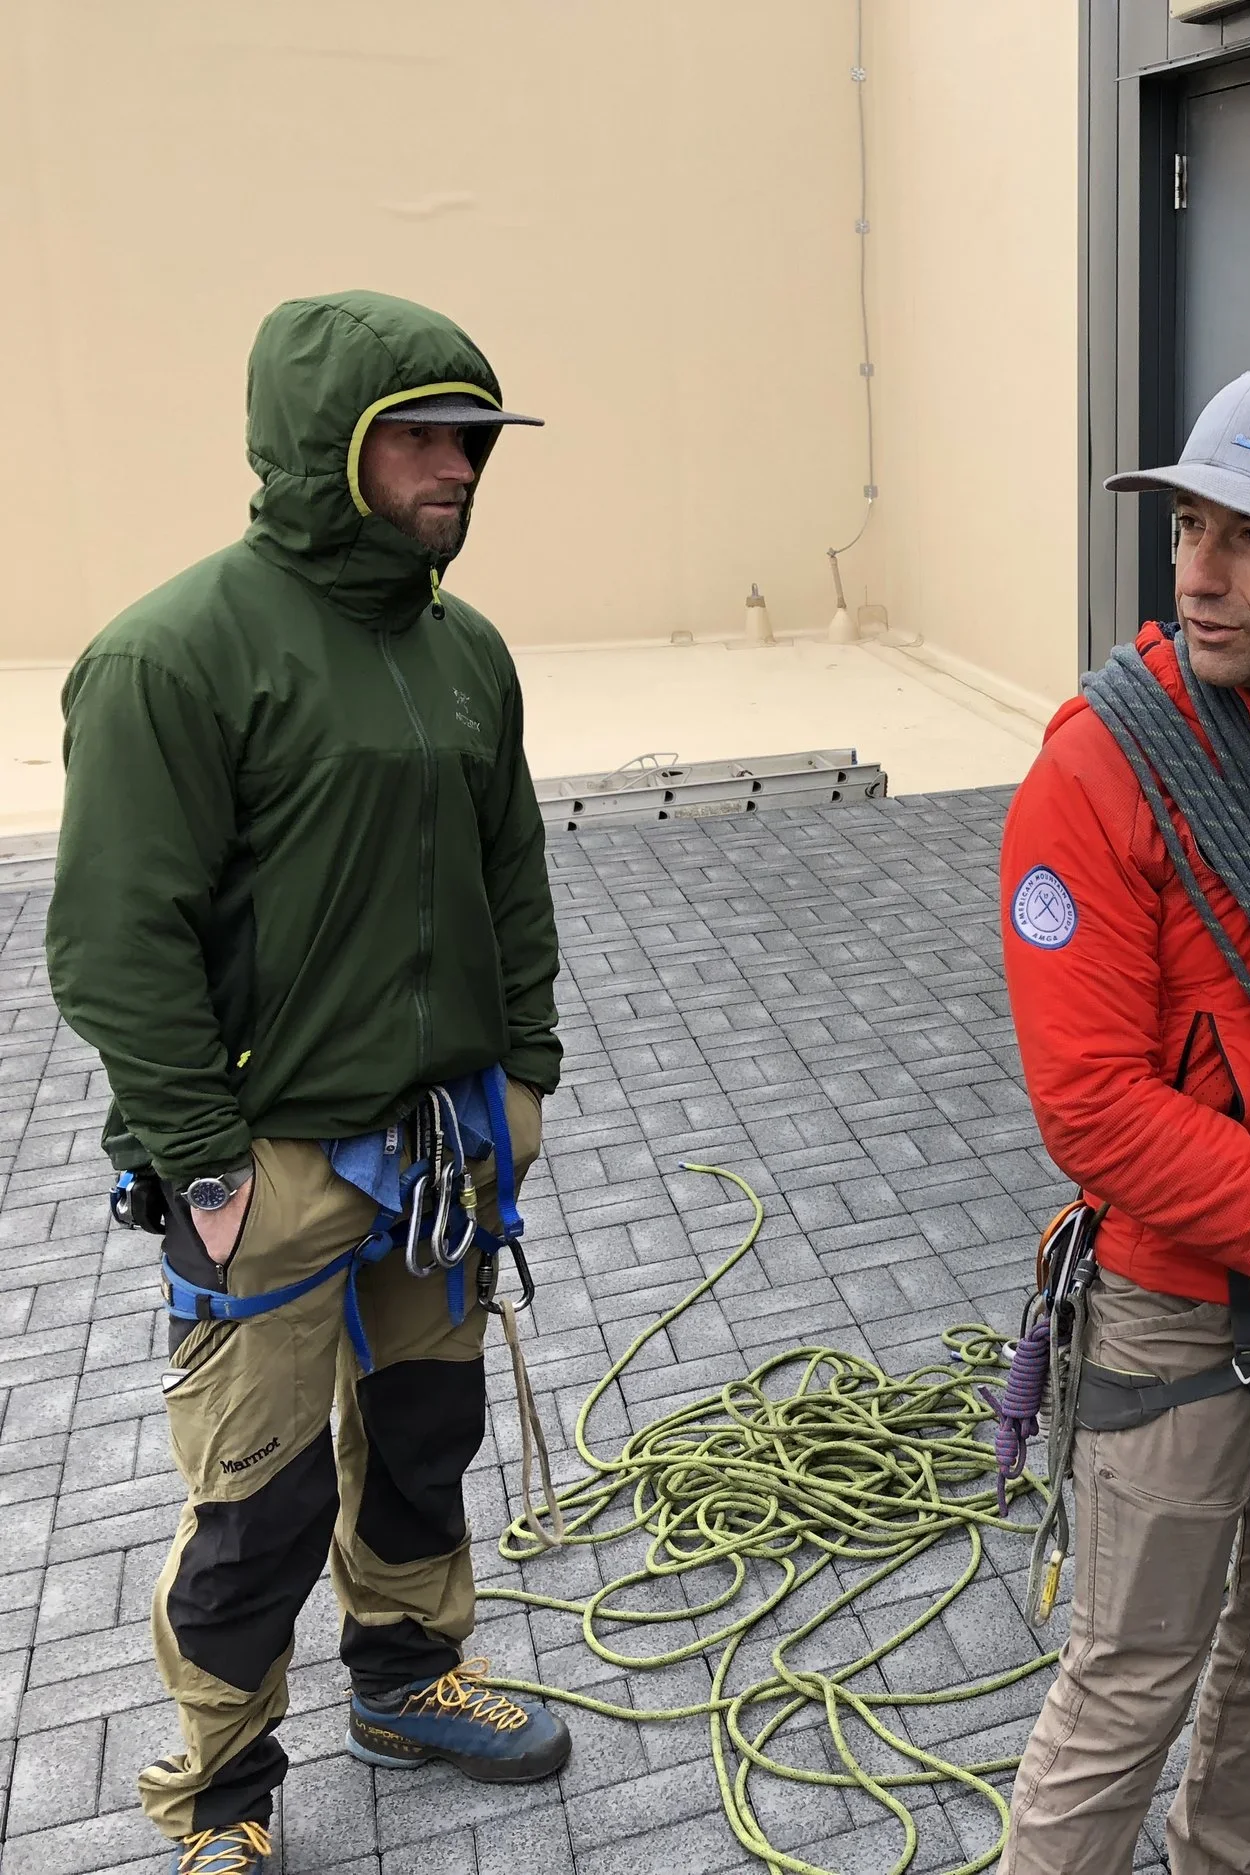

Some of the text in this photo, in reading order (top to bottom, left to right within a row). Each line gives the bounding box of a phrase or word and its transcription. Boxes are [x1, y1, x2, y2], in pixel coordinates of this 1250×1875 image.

[1018, 880, 1034, 925] AMERICAN
[1035, 873, 1067, 899] MOUNTAIN
[1032, 933, 1058, 942] AMGA
[220, 1437, 280, 1474] Marmot
